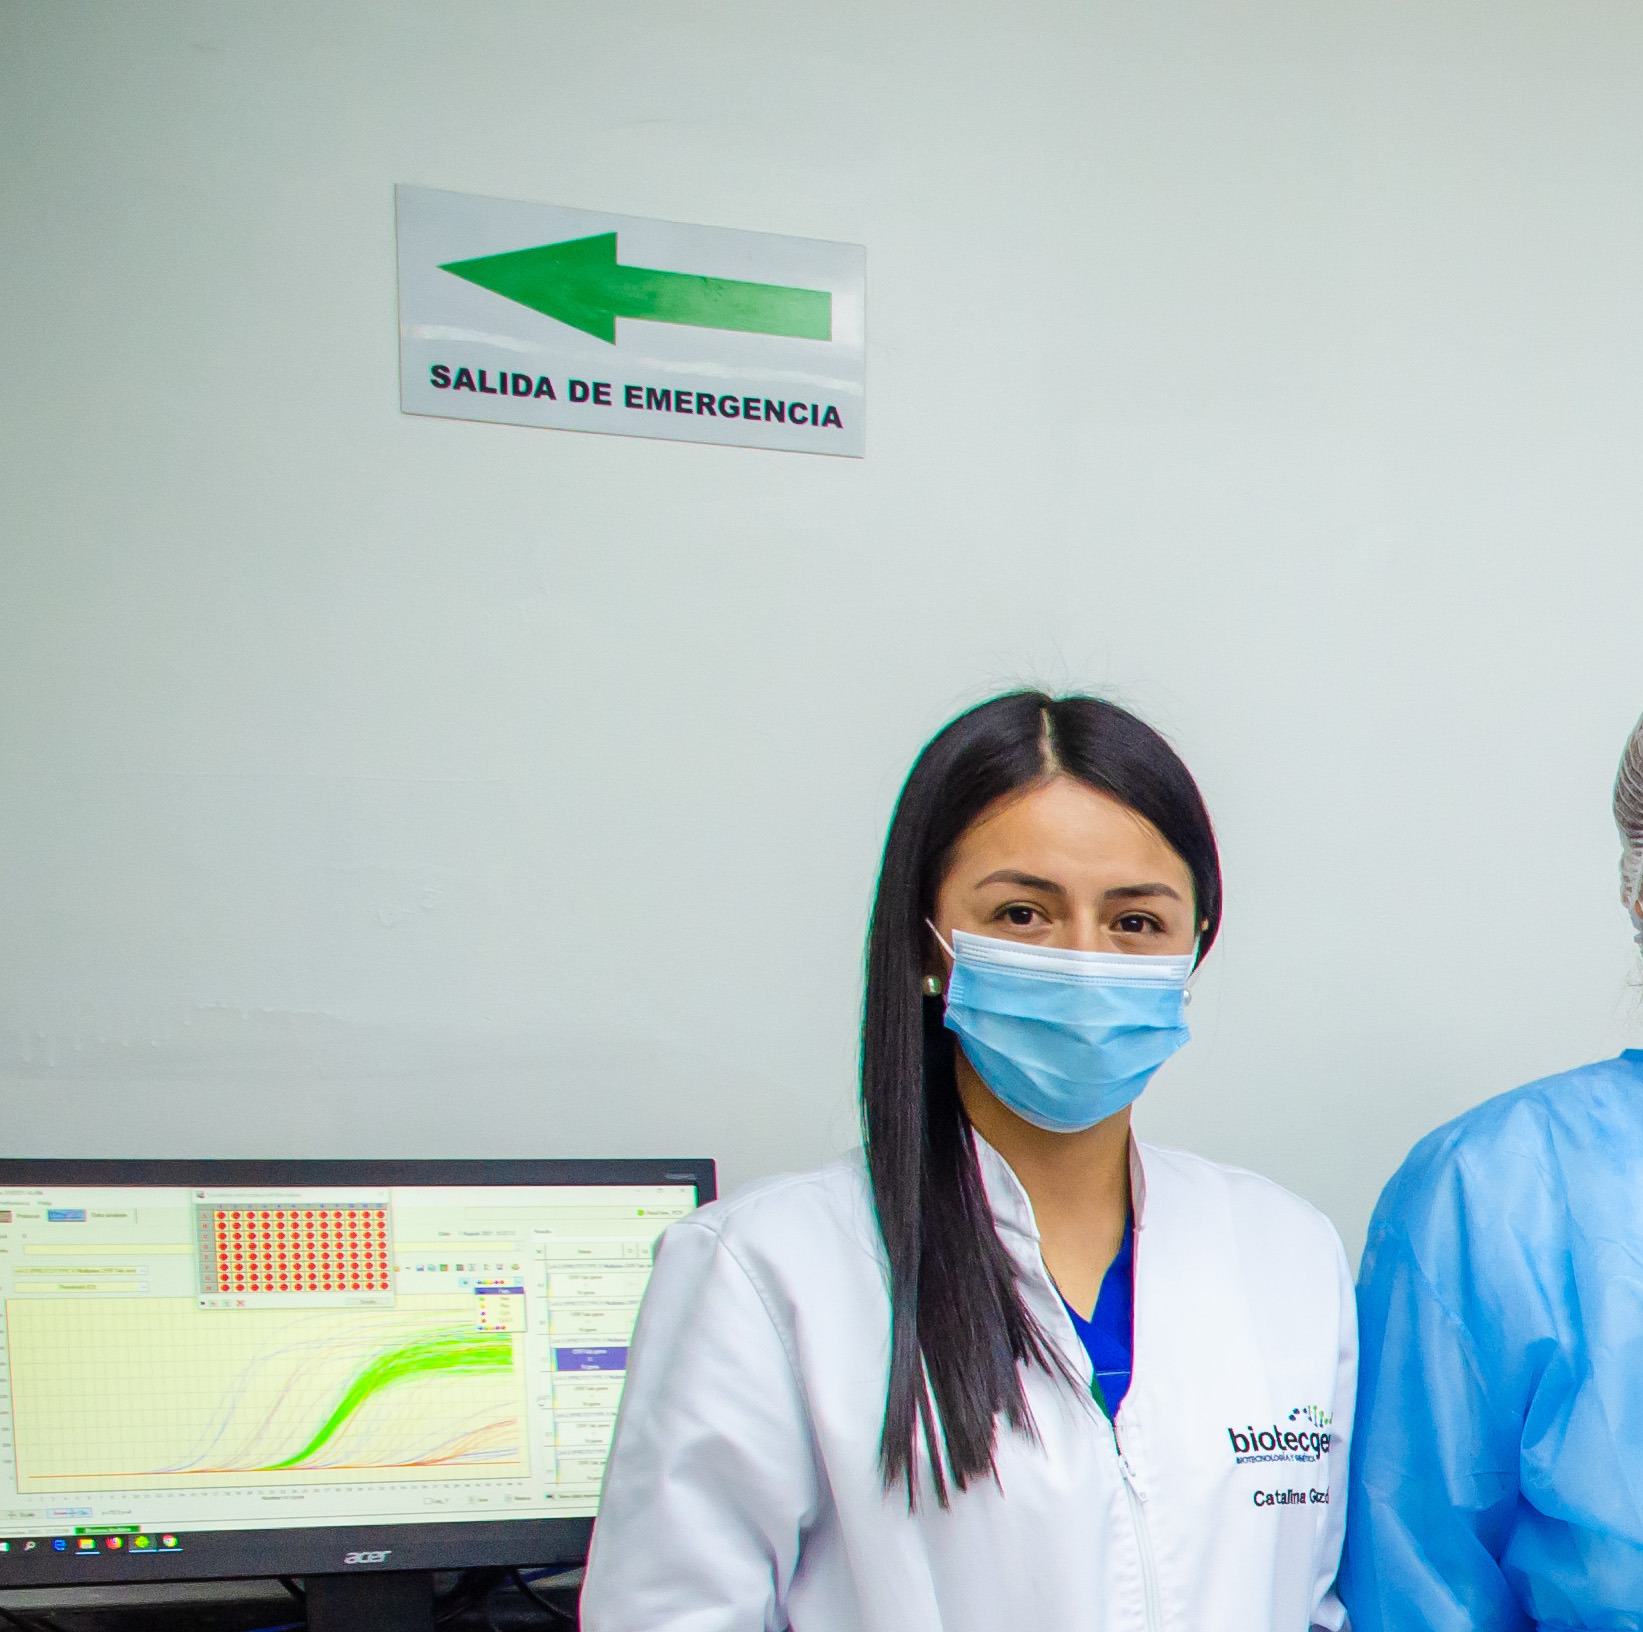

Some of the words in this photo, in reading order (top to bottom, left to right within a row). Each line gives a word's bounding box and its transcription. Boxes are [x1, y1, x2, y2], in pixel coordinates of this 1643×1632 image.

[429, 363, 557, 402] SALIDA
[568, 379, 613, 407] DE
[624, 384, 844, 430] EMERGENCIA
[1253, 1488, 1306, 1507] Catalina
[343, 1550, 392, 1564] acer
